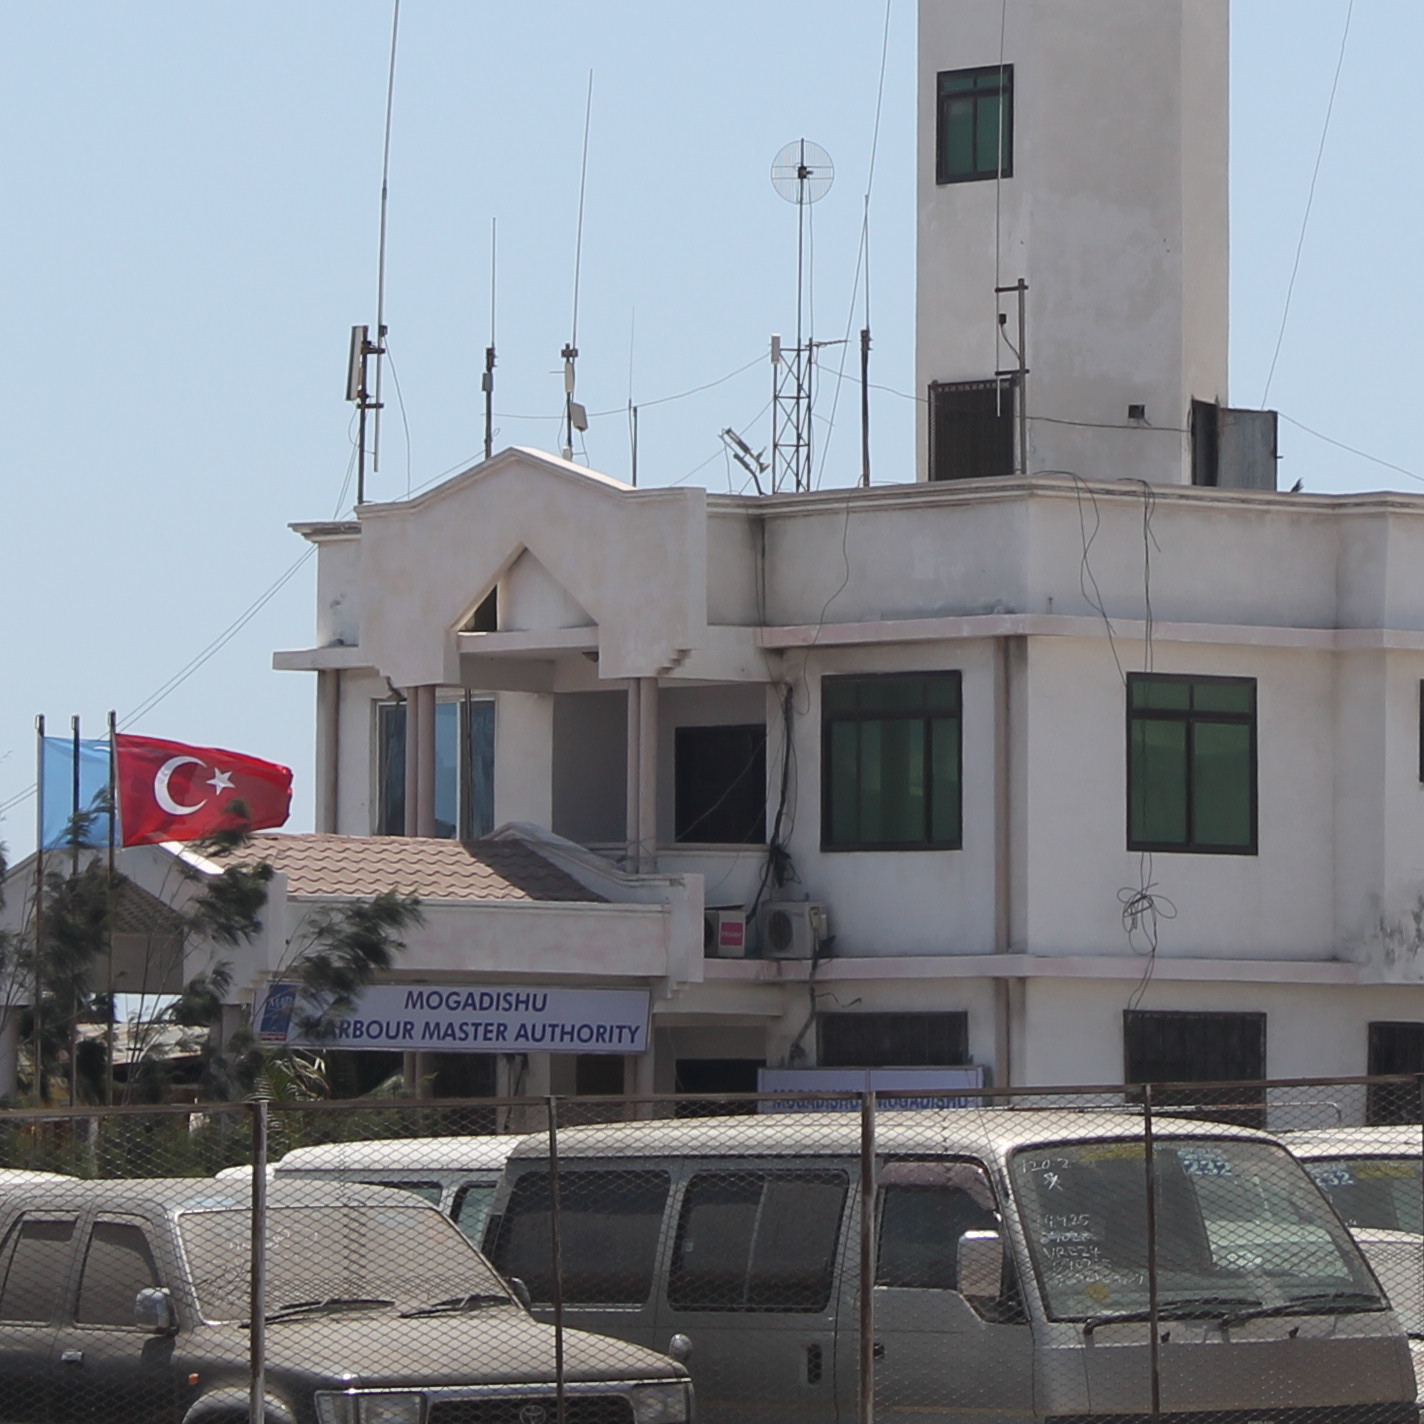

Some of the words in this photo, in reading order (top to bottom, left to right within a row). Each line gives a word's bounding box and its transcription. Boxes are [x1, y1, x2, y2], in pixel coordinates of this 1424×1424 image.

[404, 990, 548, 1012] MOGADISHU
[421, 1020, 508, 1042] MASTER
[514, 1023, 641, 1044] AUTHORITY
